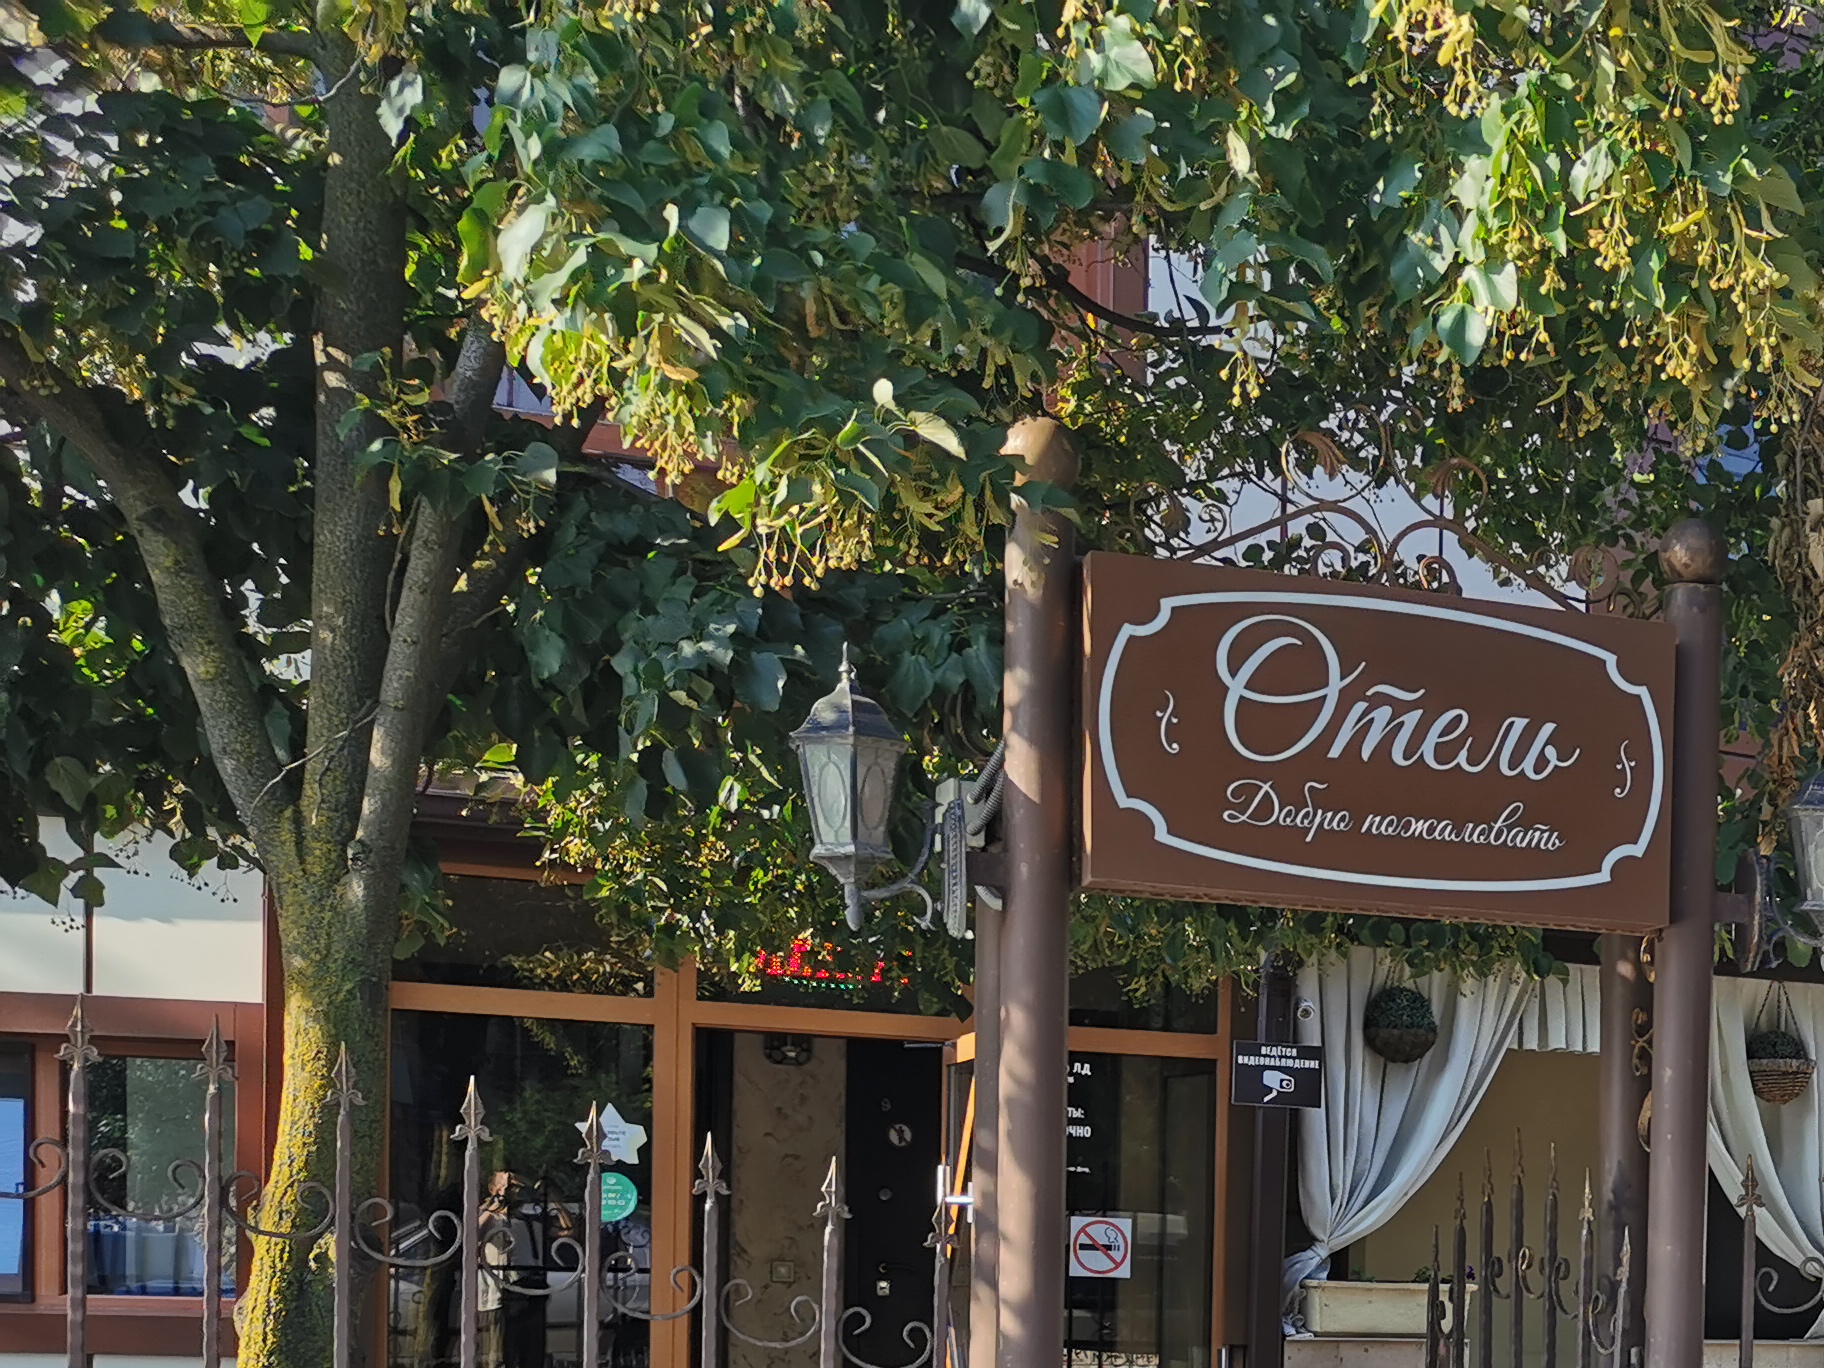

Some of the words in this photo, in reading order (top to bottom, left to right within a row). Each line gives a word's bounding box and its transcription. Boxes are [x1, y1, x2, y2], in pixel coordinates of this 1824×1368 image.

[1215, 614, 1580, 781] Отель
[1222, 779, 1354, 843] Добро
[1361, 802, 1567, 852] пожаловать
[1237, 1055, 1320, 1069] ВИДЕОНАБЛЮДЕНИЕ
